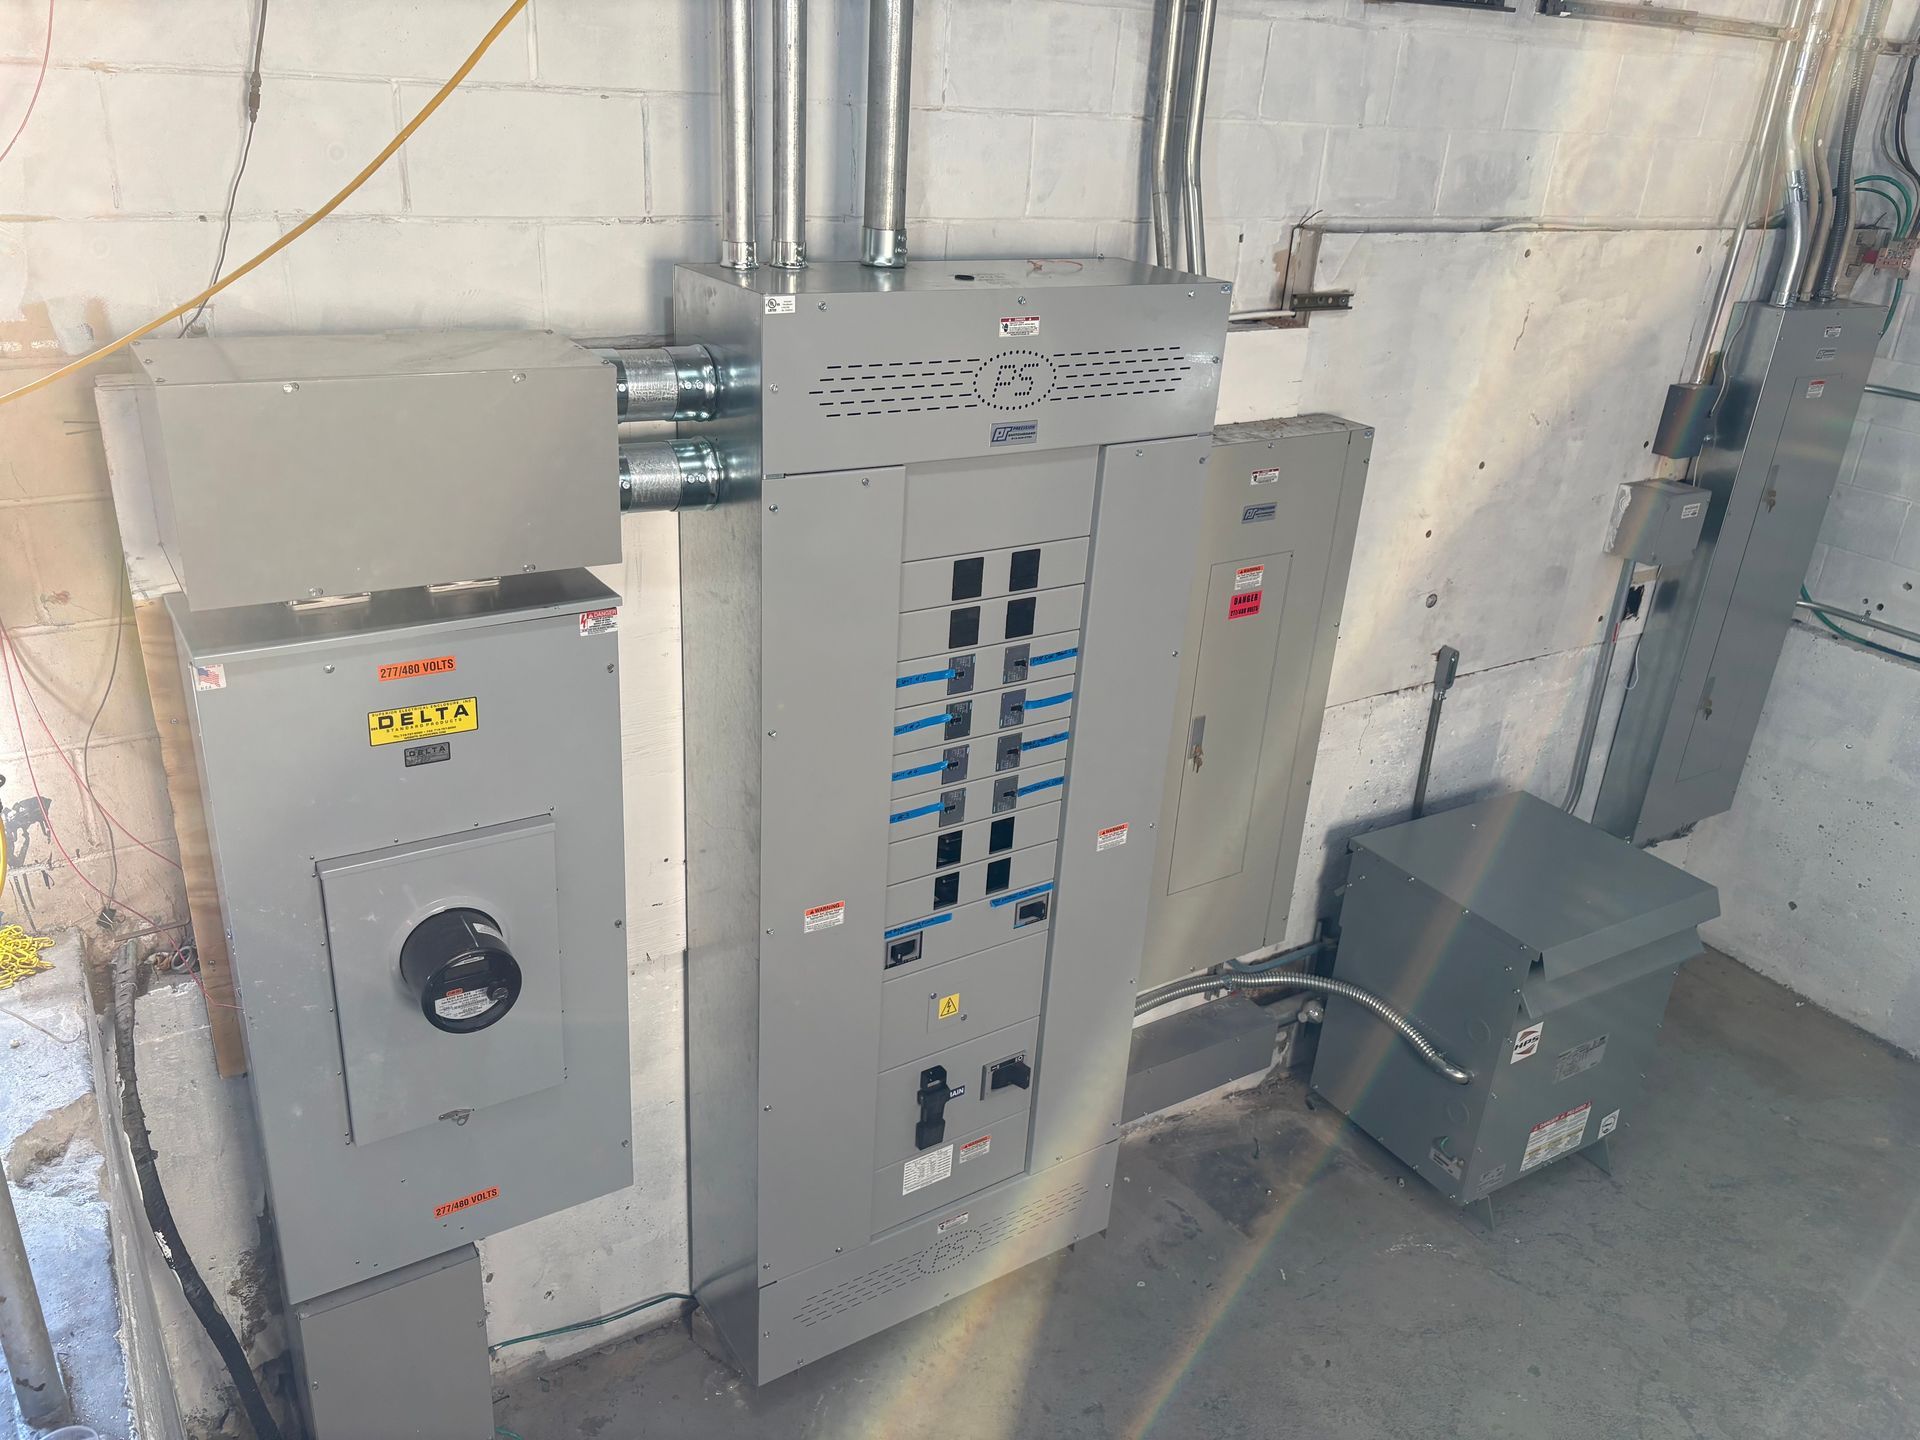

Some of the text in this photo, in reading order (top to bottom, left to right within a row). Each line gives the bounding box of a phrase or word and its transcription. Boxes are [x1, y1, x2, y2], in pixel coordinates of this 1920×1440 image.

[1234, 593, 1258, 605] DANGER
[594, 609, 617, 618] DANGER
[380, 659, 454, 678] 277/480 VOLTS
[378, 704, 469, 729] DELTA
[399, 705, 429, 713] ELECTRICAL
[386, 723, 424, 733] STANDARD
[426, 718, 462, 726] PRODUCTS
[815, 902, 840, 914] WARNING
[1514, 1034, 1539, 1051] HPS
[435, 1188, 498, 1216] 277/480 VOLTS
